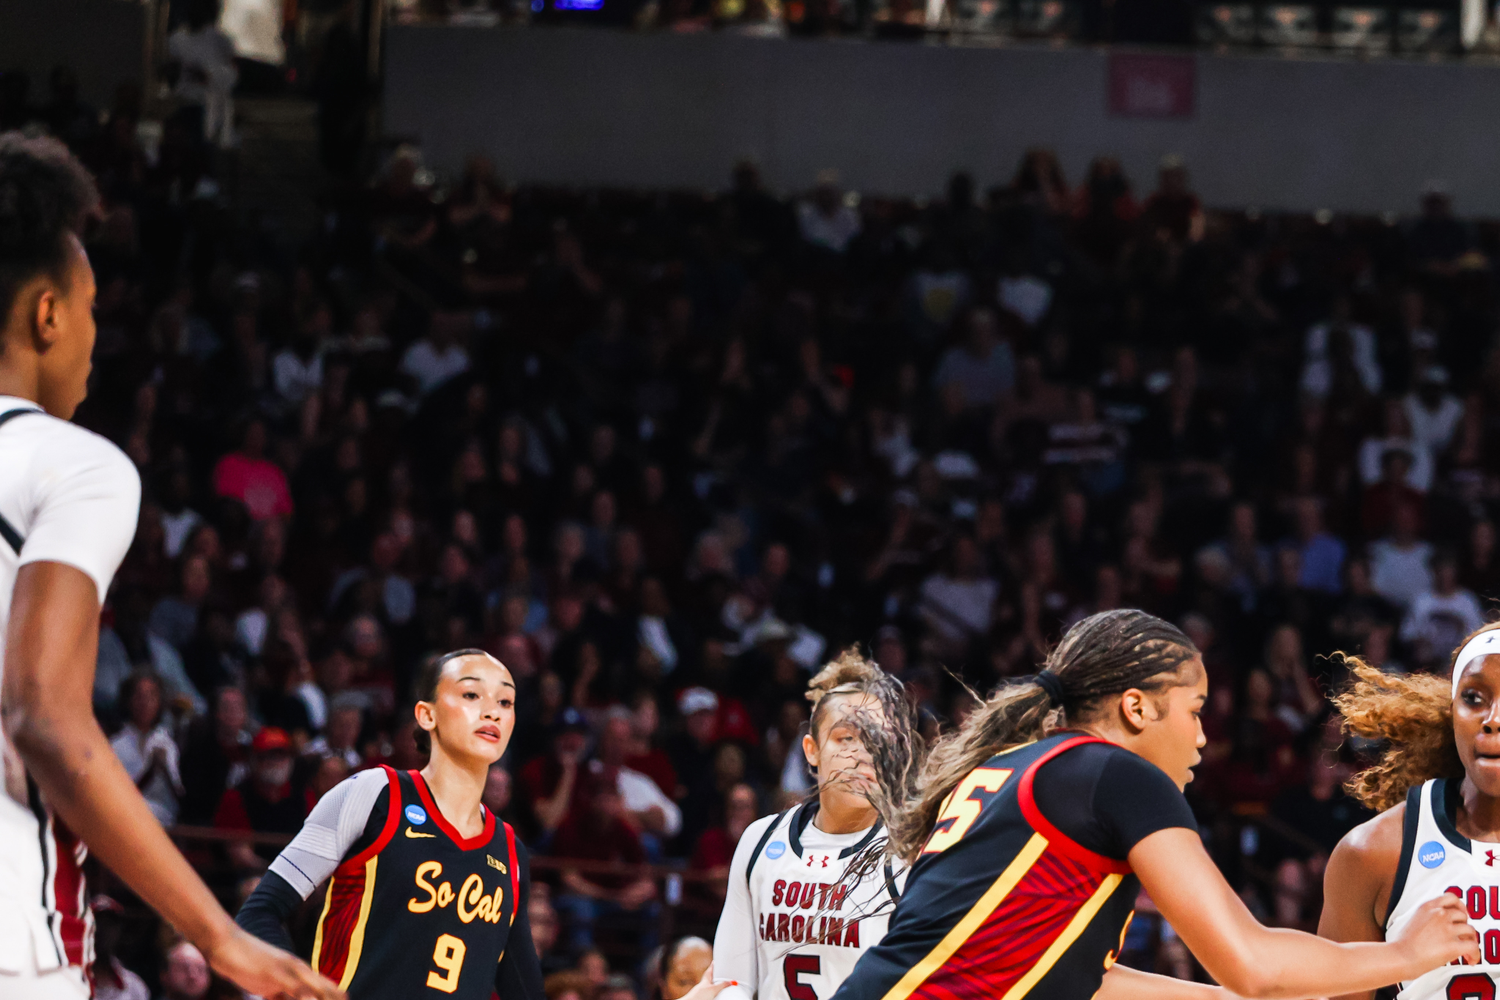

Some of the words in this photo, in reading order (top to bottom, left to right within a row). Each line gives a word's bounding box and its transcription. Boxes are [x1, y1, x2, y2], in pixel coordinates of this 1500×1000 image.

[916, 767, 1015, 859] 5
[1422, 851, 1445, 863] NCAA
[408, 860, 456, 914] So
[457, 873, 504, 924] Cal
[772, 878, 848, 911] SOUTH
[426, 933, 467, 994] 9
